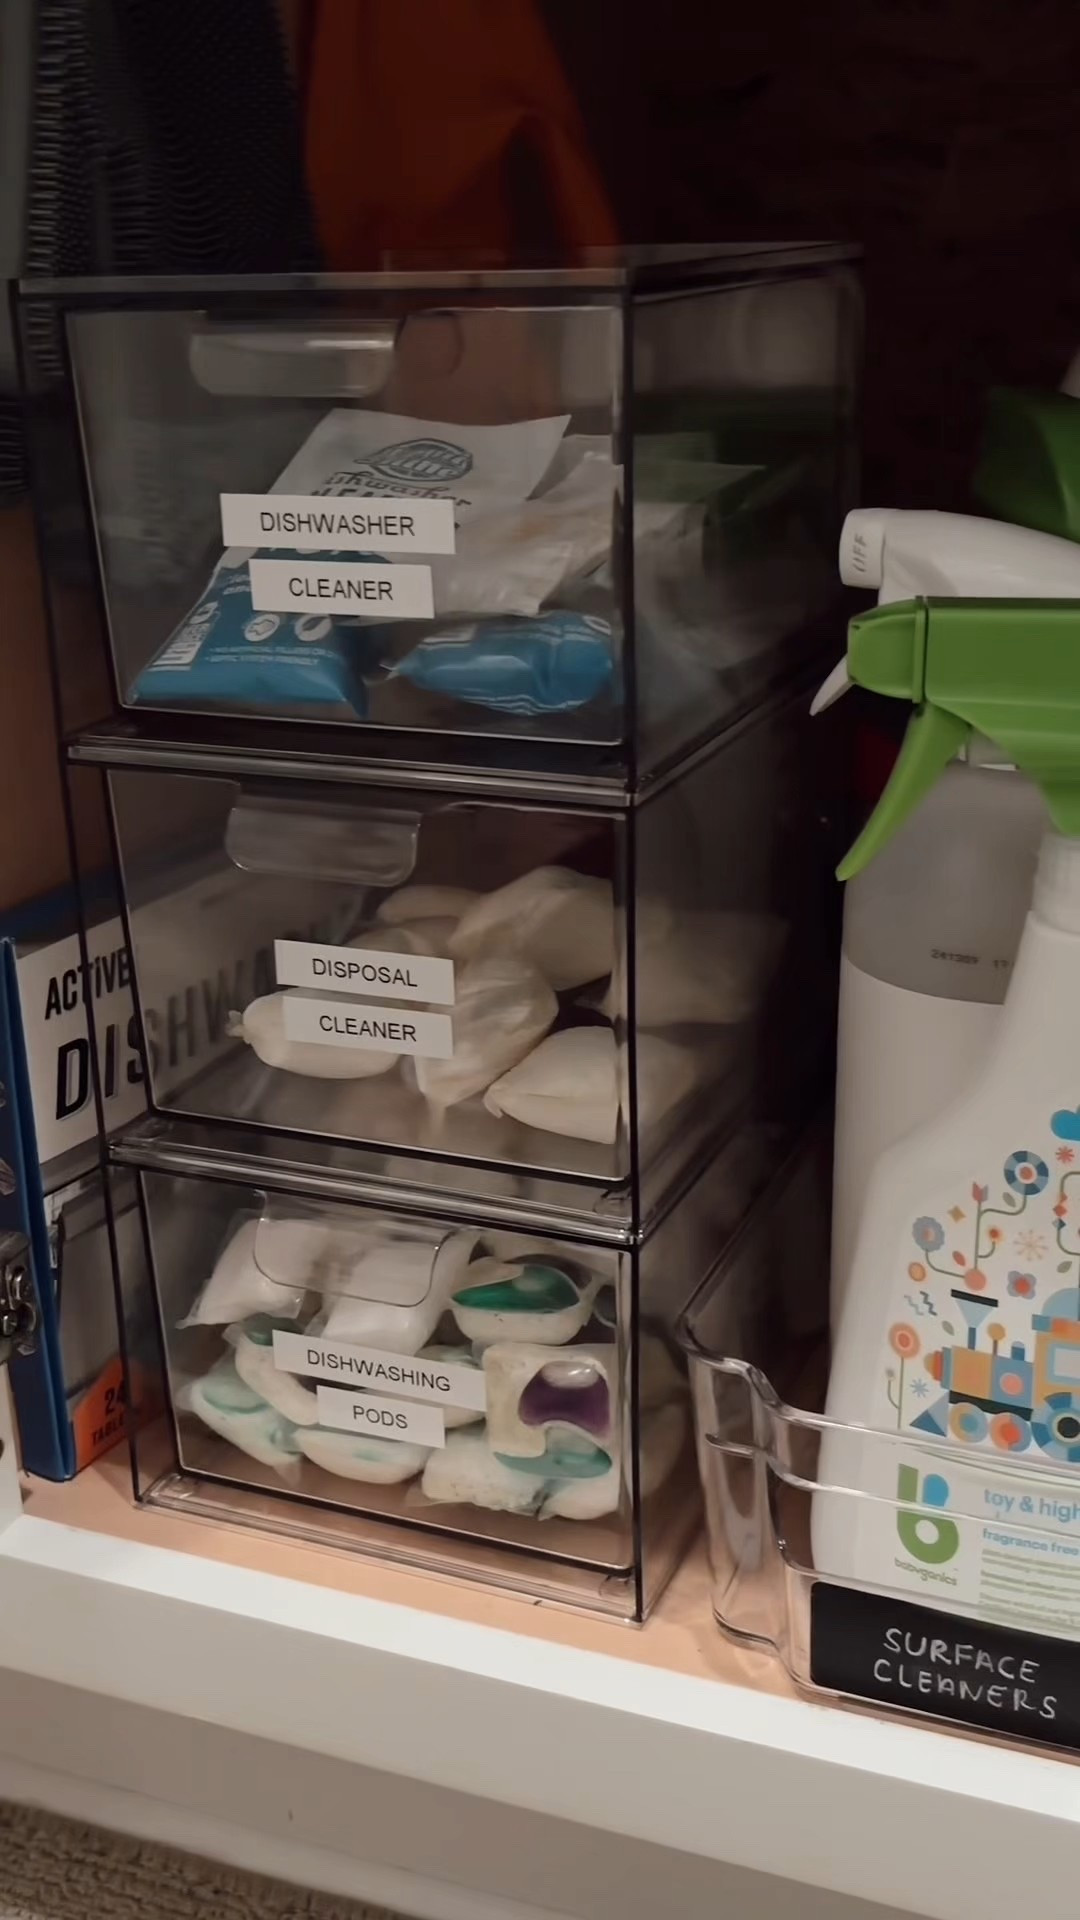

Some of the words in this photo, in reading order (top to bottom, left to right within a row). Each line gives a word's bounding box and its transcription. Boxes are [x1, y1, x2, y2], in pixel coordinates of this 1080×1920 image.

[260, 512, 416, 537] DISHWASHER
[288, 577, 394, 602] CLEANER
[312, 957, 418, 988] DISPOSAL
[319, 1014, 417, 1042] CLEANER
[307, 1348, 451, 1393] DISHWASHING
[352, 1404, 408, 1430] PODS
[984, 1488, 1015, 1513] toy
[1019, 1495, 1034, 1513] &
[982, 1528, 1049, 1551] fragrance
[1050, 1541, 1080, 1556] free
[883, 1627, 1039, 1684] SURFACE
[873, 1658, 1057, 1719] CLEANERS
